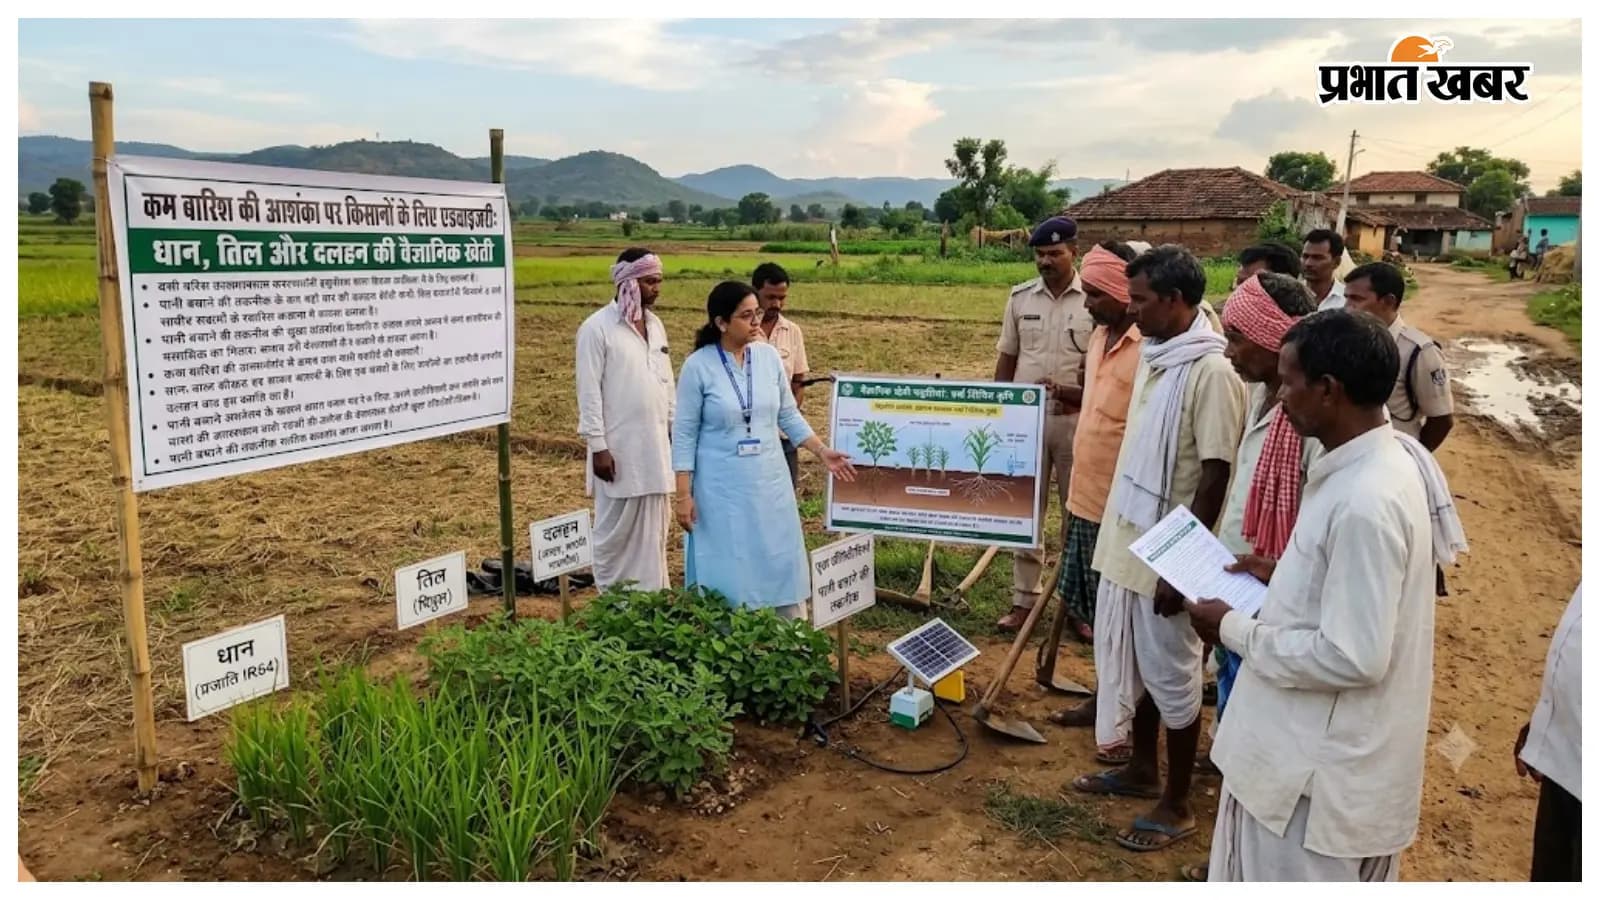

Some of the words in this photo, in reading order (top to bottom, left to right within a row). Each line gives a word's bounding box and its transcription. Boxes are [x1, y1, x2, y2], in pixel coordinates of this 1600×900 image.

[142, 193, 176, 220] कम
[181, 188, 233, 222] बारिश
[237, 190, 260, 222] की
[265, 192, 320, 224] आशंका
[324, 202, 343, 225] पर
[345, 195, 393, 226] किसानों
[396, 199, 410, 225] के
[412, 199, 437, 227] लिए
[153, 240, 210, 270] धान,
[217, 233, 263, 265] तिल
[270, 234, 308, 264] और
[312, 242, 369, 264] दलहन
[373, 237, 396, 264] की
[464, 238, 495, 262] खेती
[416, 568, 447, 591] तिल
[217, 639, 255, 664] धान
[195, 671, 239, 700] (प्रजाति
